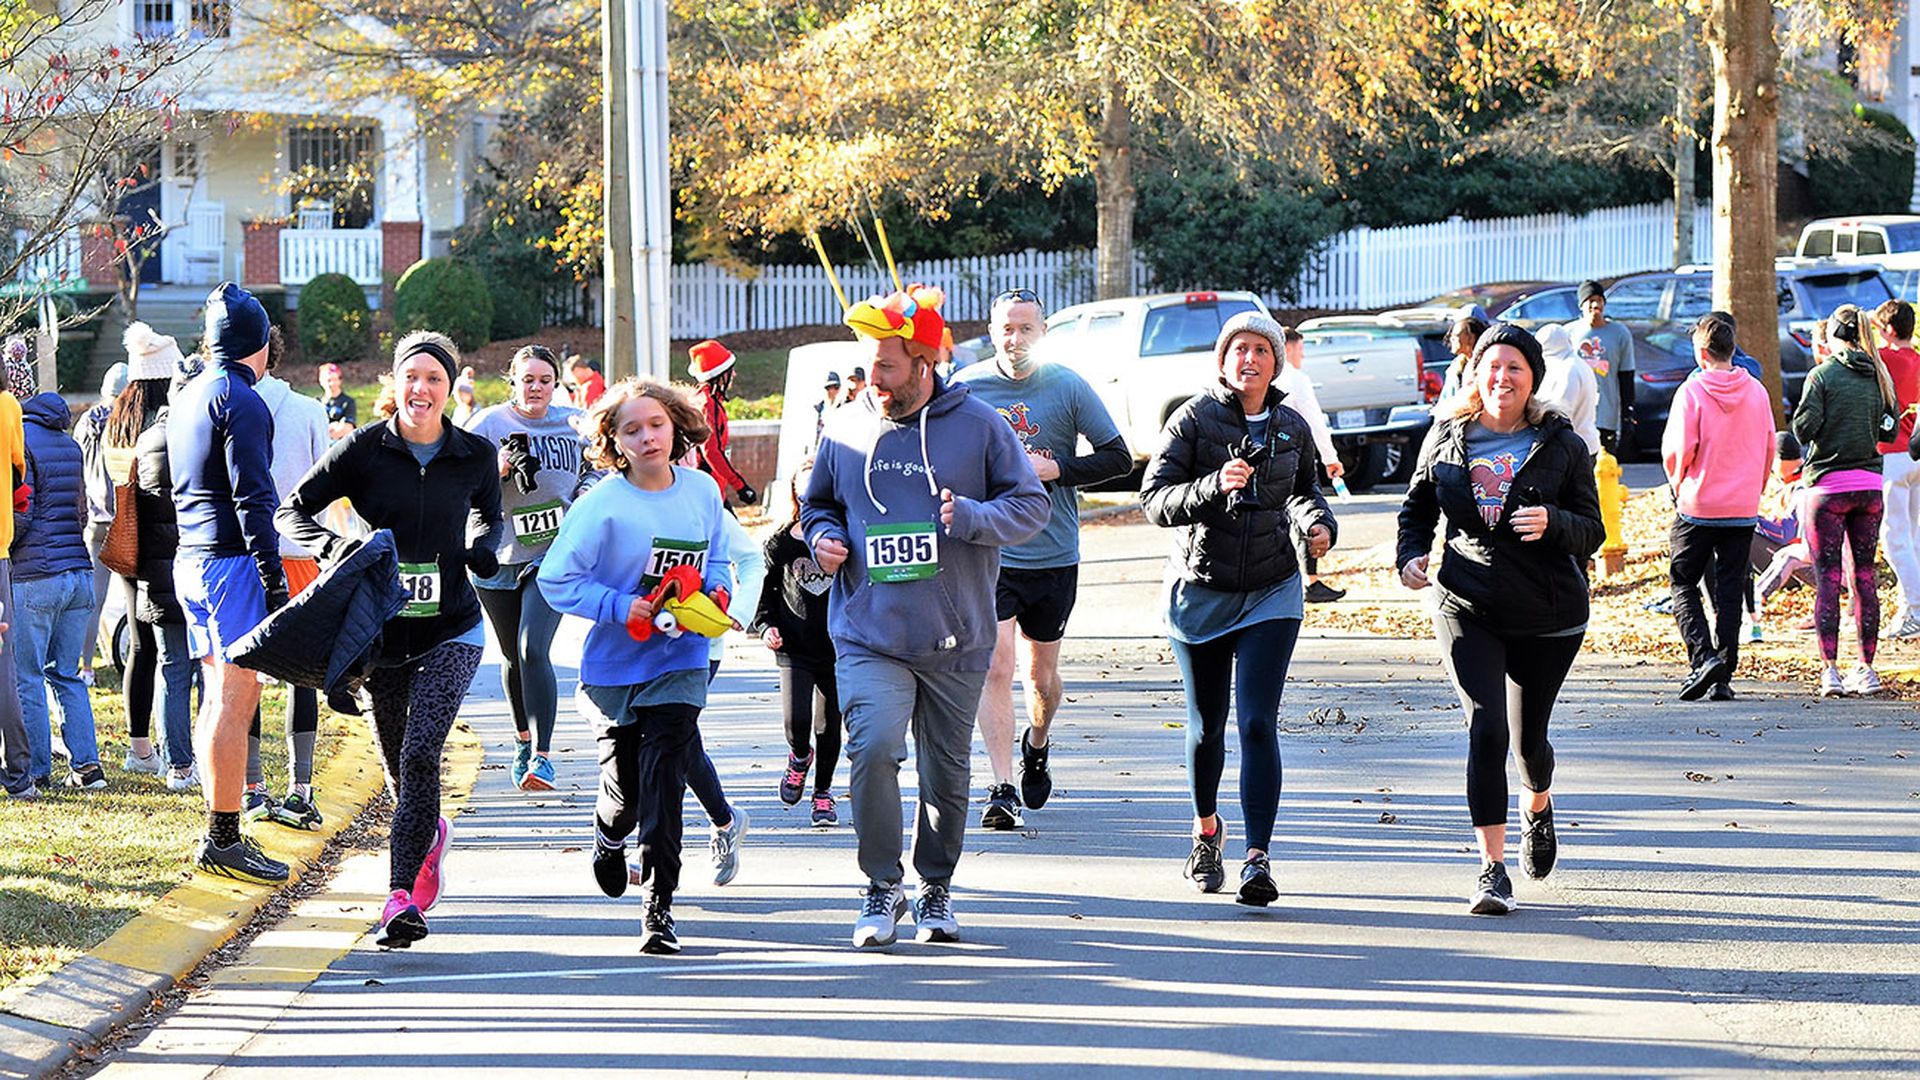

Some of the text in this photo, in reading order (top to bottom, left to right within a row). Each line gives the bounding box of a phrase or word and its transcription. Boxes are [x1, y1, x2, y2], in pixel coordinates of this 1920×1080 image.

[530, 435, 577, 474] MSON
[892, 460, 902, 470] is
[519, 509, 558, 534] 1211
[869, 535, 932, 565] 1595
[399, 575, 433, 601] 18
